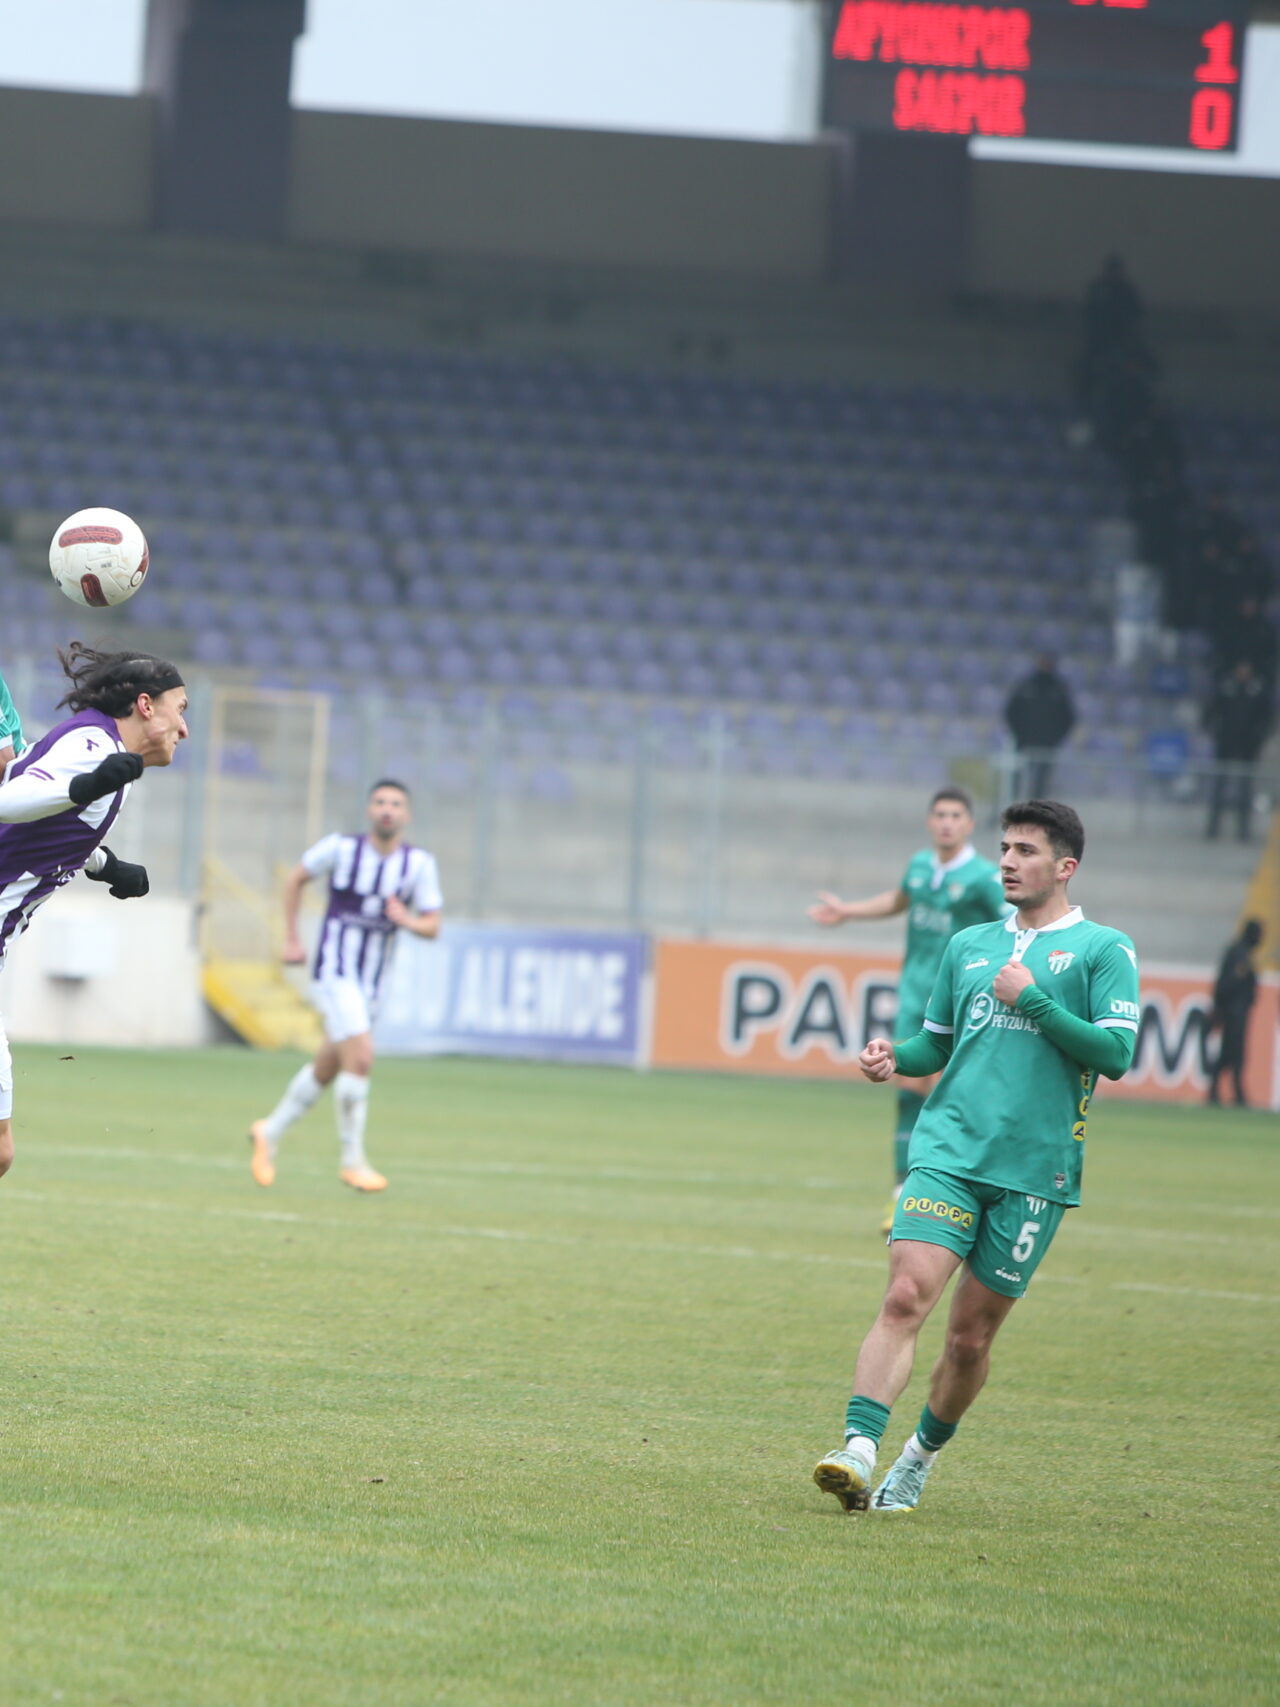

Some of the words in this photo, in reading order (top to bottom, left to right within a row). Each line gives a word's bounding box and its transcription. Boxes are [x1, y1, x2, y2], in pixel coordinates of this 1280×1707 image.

[1194, 20, 1238, 84] 1
[1188, 87, 1233, 150] 0
[904, 1198, 971, 1227] FURPA
[1011, 1220, 1041, 1263] 5
